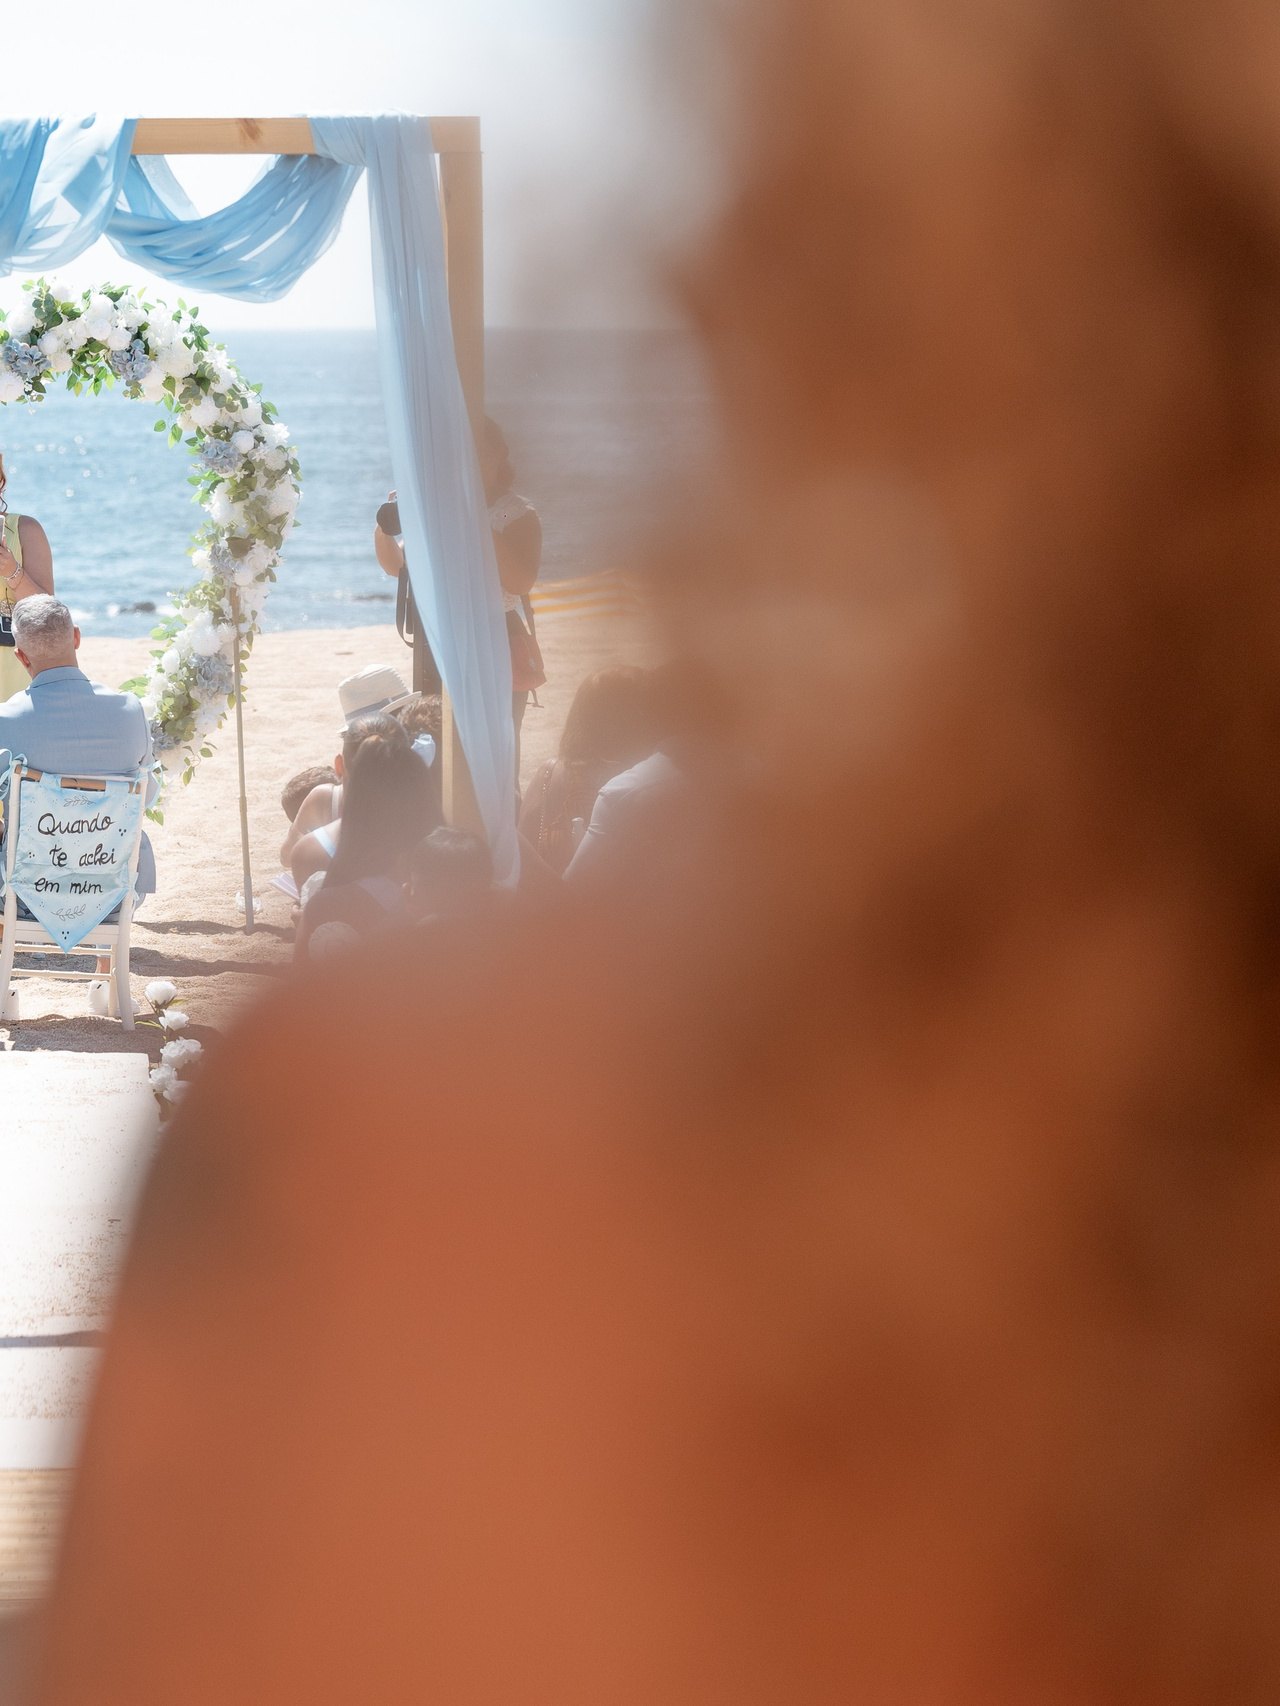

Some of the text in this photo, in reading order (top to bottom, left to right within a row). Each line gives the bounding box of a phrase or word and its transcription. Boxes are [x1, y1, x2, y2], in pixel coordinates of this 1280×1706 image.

[38, 812, 114, 836] Quando
[49, 843, 117, 867] te achei
[34, 878, 103, 894] em mim
